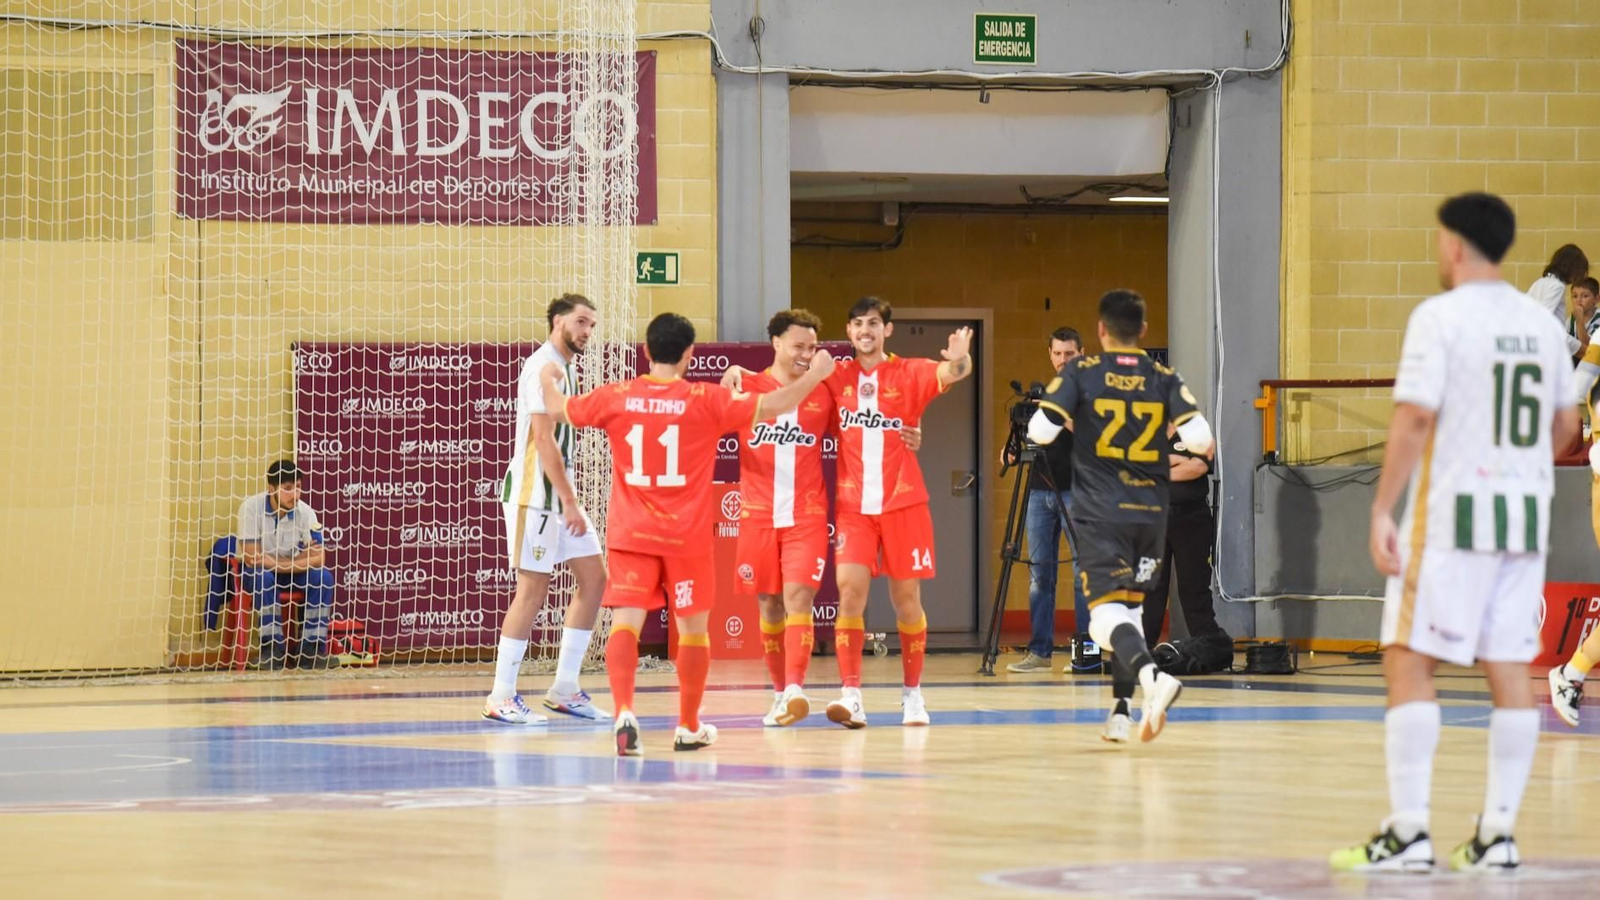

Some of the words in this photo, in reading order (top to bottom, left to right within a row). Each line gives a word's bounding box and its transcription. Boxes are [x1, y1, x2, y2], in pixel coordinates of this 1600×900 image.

[984, 20, 1013, 37] SALIDA
[1015, 21, 1026, 37] DE
[979, 40, 1031, 57] EMERGENCIA
[304, 87, 637, 159] IMDECO
[201, 168, 291, 192] Instituto
[298, 173, 404, 200] Municipal
[409, 174, 436, 195] de
[444, 175, 541, 199] Deportes
[409, 355, 473, 370] IMDECO
[688, 355, 729, 370] DECO
[362, 397, 426, 411] IMDECO
[625, 397, 686, 415] WALTINHO
[1493, 362, 1543, 447] 16
[749, 420, 815, 446] Jimbee
[1094, 398, 1165, 462] 22
[299, 439, 342, 454] DECO
[420, 439, 482, 454] IMDECO
[624, 424, 687, 487] 11
[362, 481, 426, 496] IMDECO
[538, 513, 549, 535] 7
[419, 526, 482, 541] IMDECO
[911, 547, 933, 571] 14
[363, 569, 427, 583] IMDECO
[811, 556, 826, 582] 3
[420, 610, 484, 625] IMDECO
